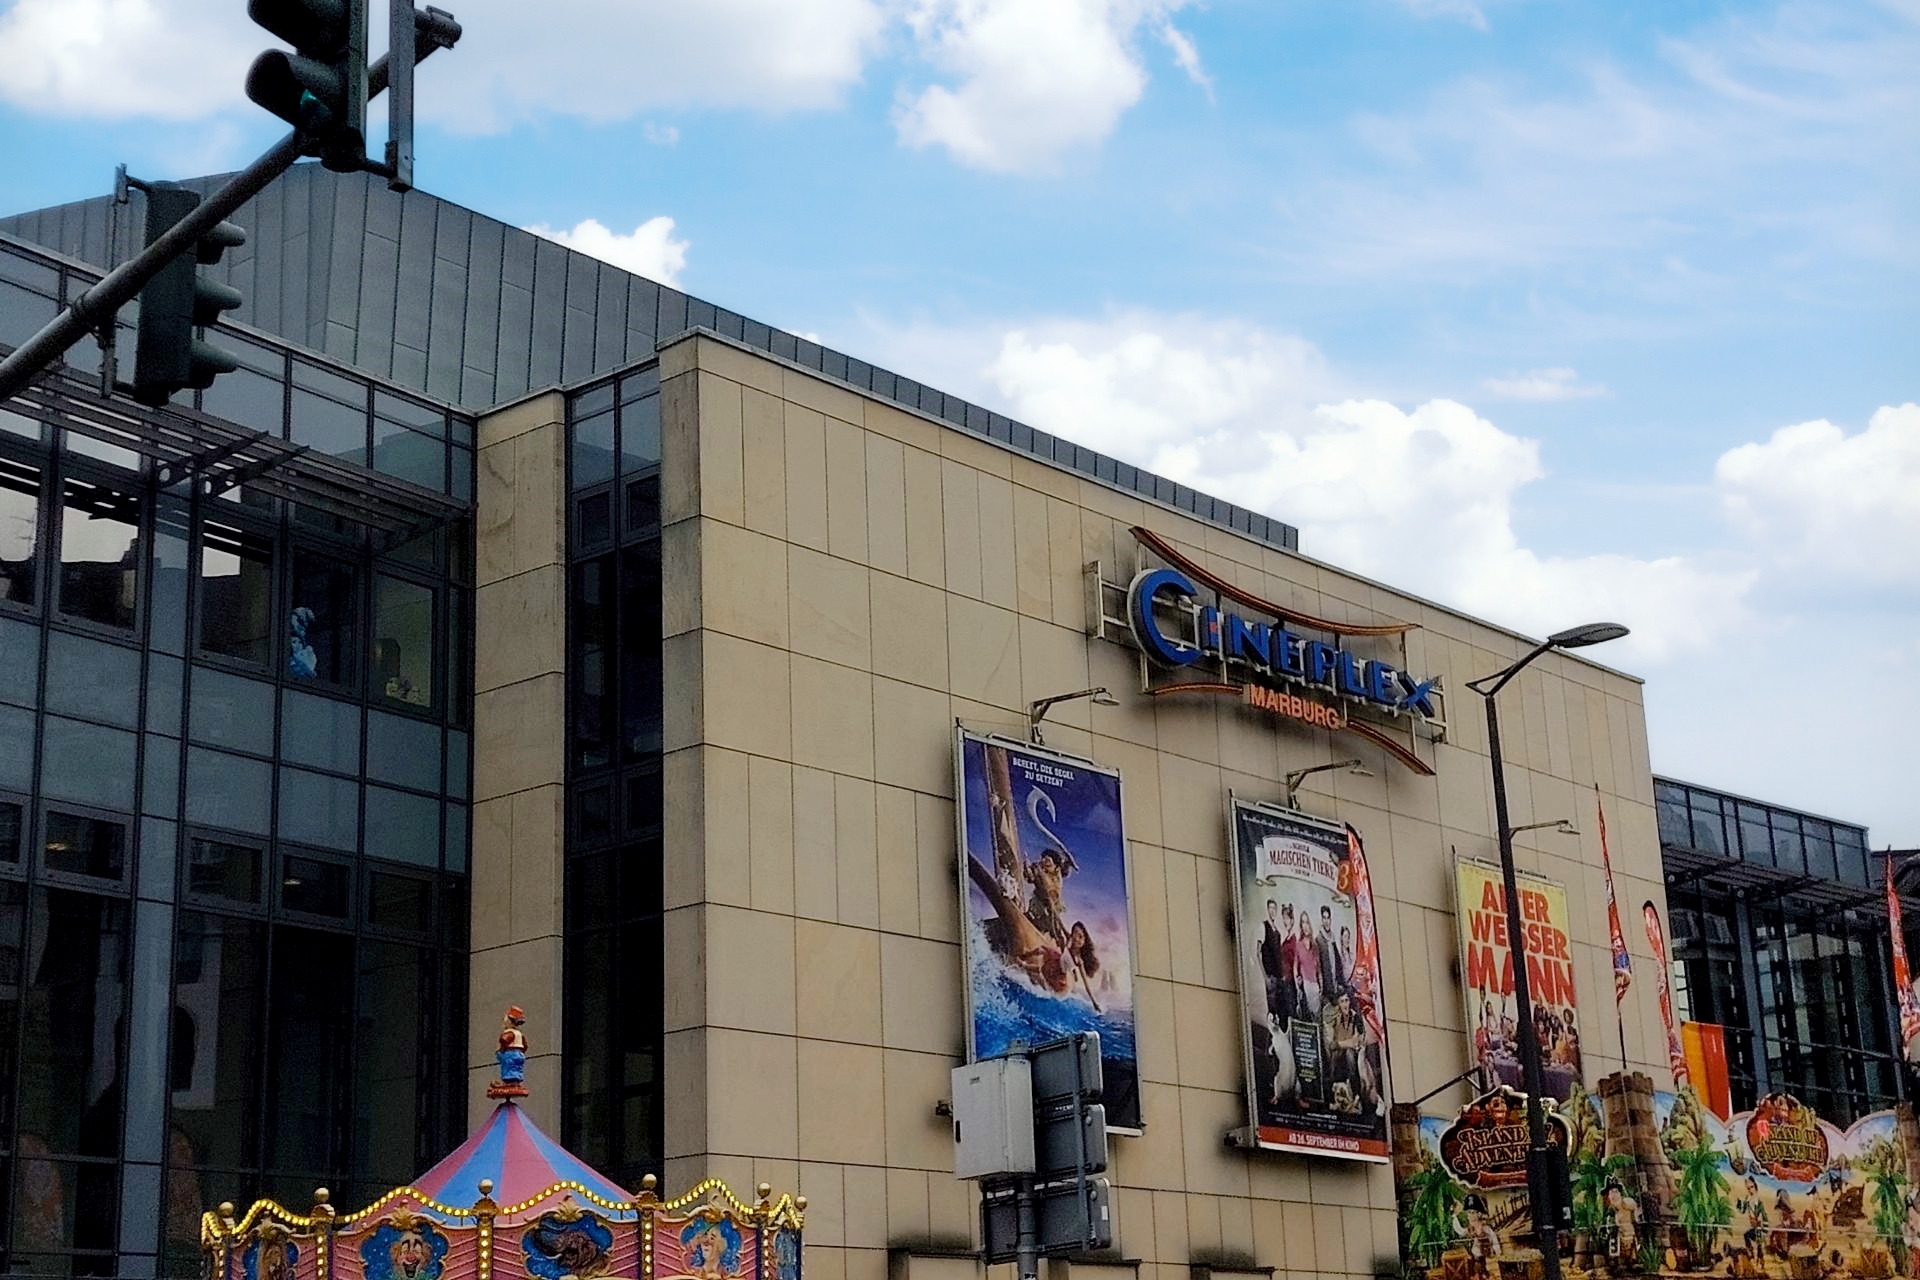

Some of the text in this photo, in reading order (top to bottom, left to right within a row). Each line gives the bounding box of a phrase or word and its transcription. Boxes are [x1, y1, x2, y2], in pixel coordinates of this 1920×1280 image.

[1130, 568, 1436, 718] CINEPLEX
[1249, 684, 1340, 730] MARBURG
[1270, 850, 1335, 881] MAGISCHEN TIERE
[1339, 863, 1350, 890] 3
[1306, 1134, 1337, 1149] SEPTEMBER
[1458, 1126, 1526, 1151] ISLAND
